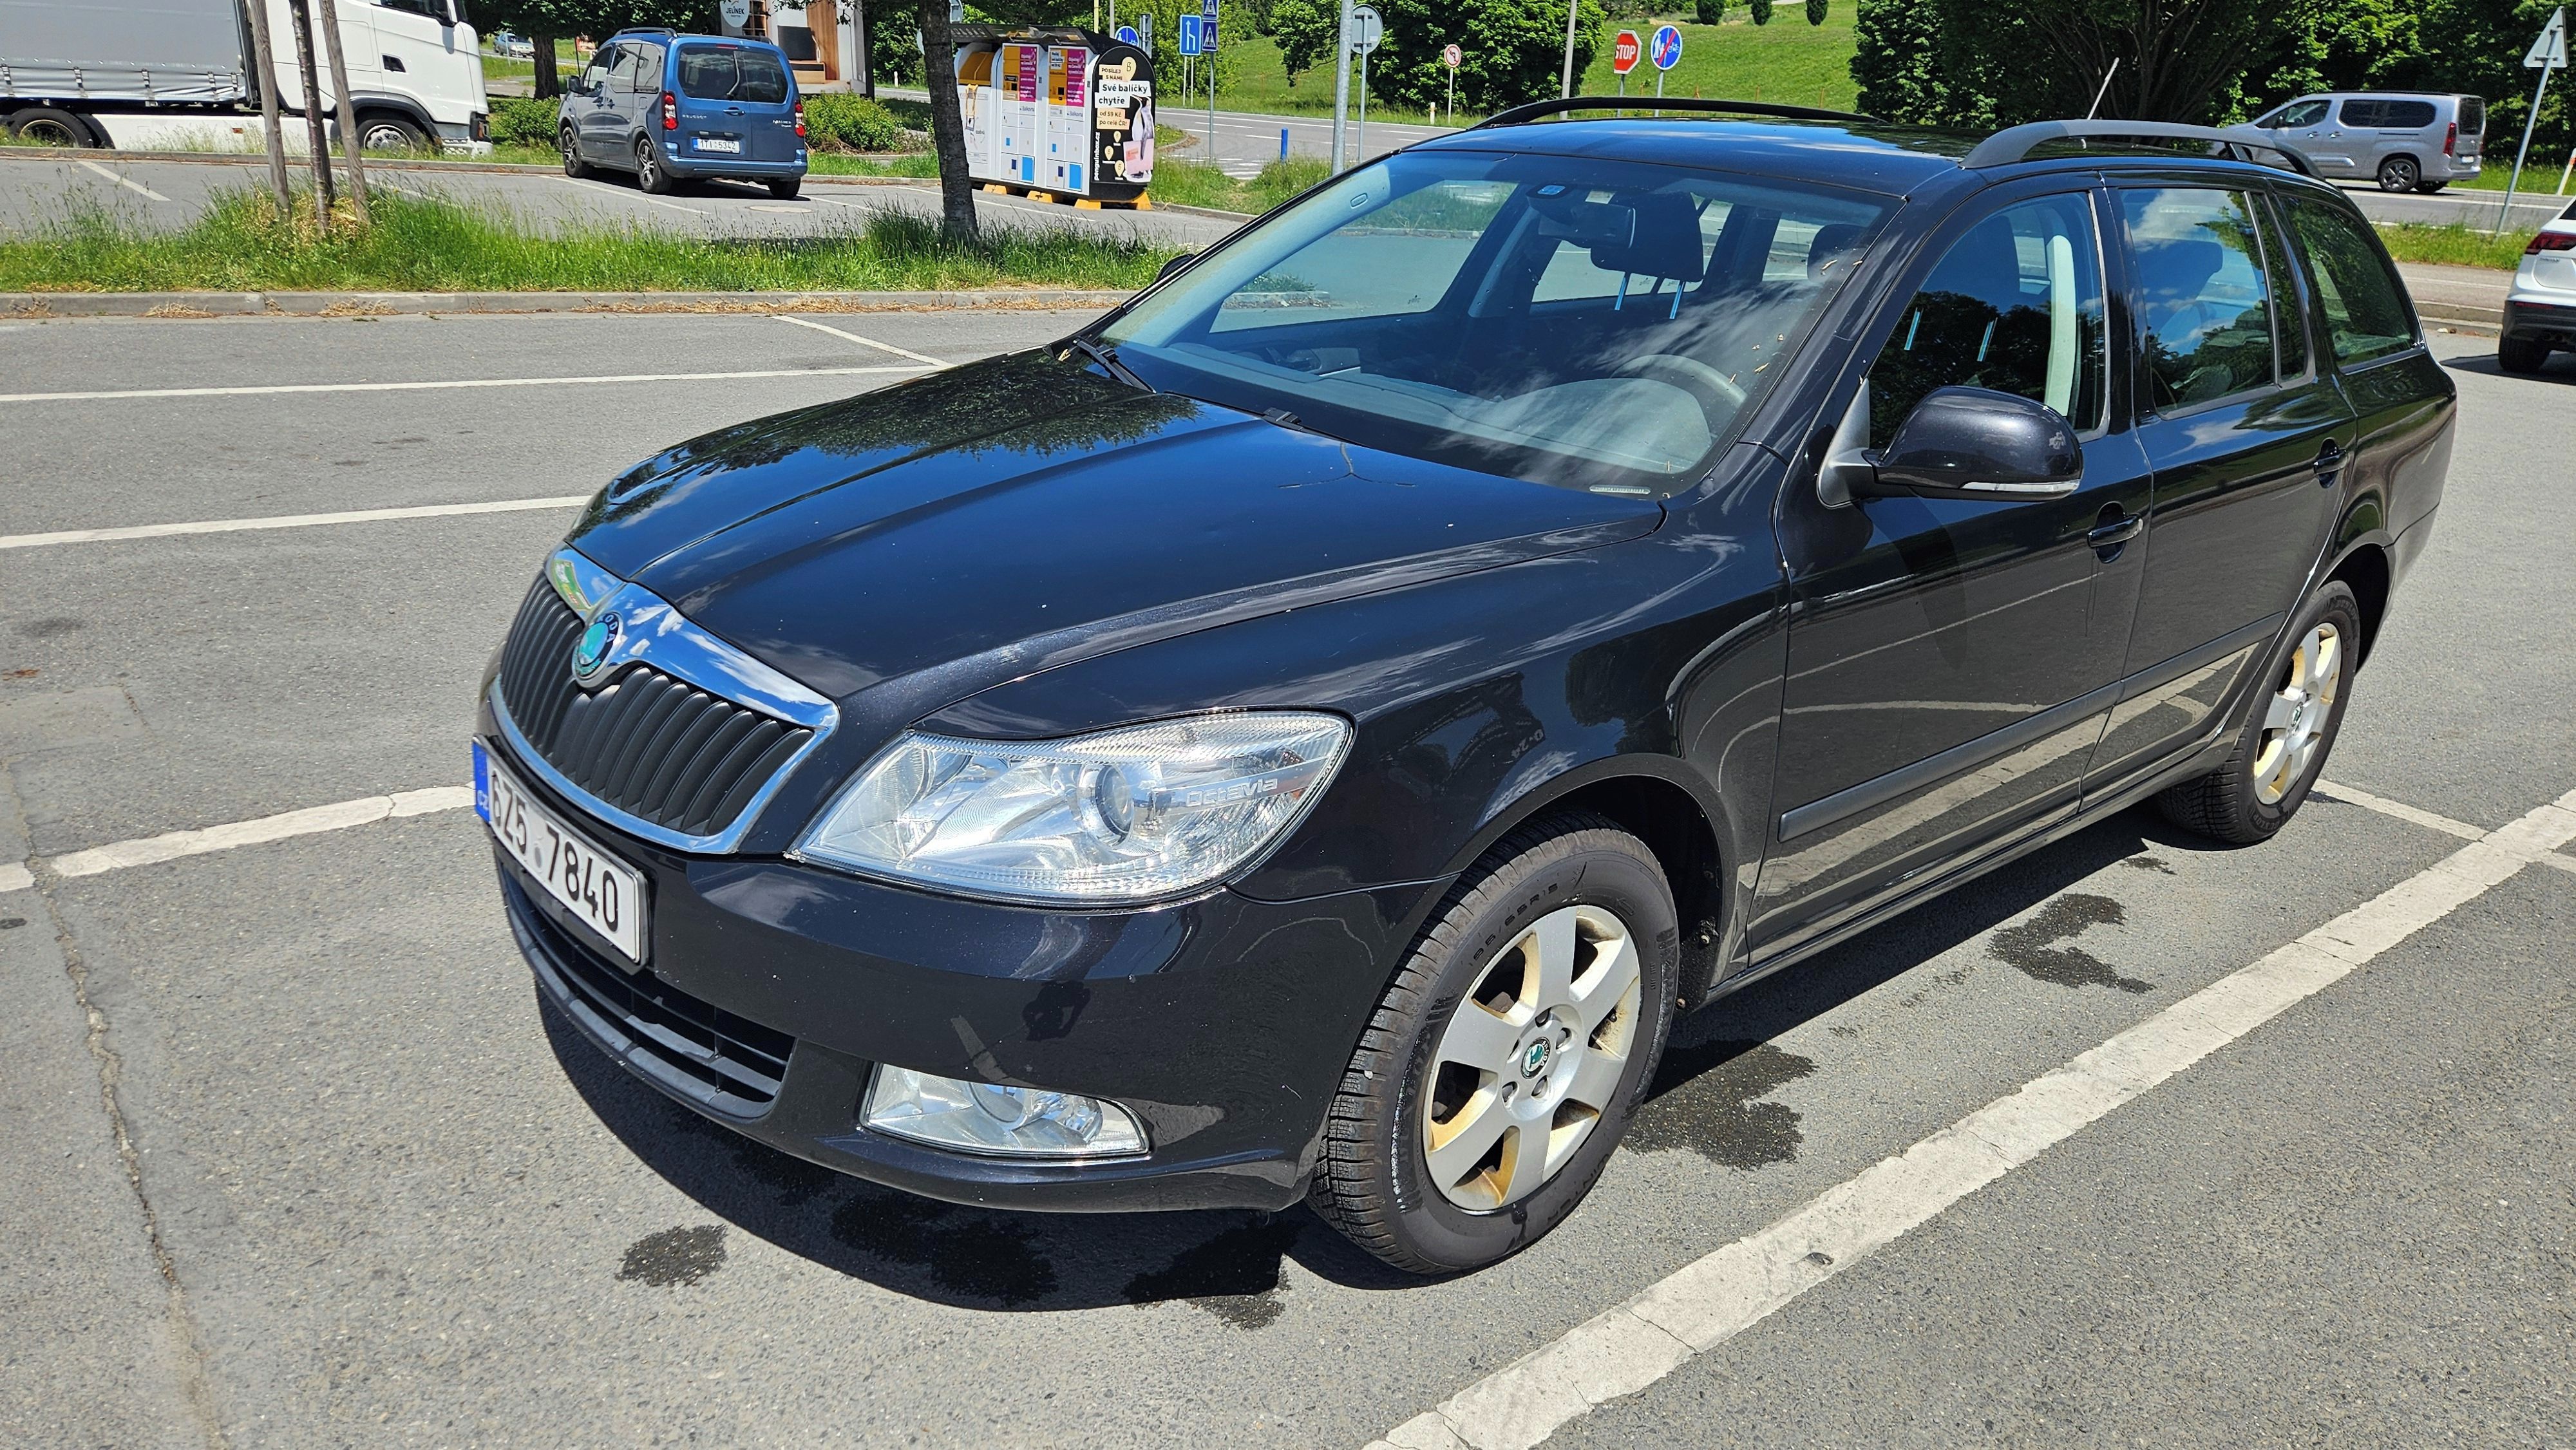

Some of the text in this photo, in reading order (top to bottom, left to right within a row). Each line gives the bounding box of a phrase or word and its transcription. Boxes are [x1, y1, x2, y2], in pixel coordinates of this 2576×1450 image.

[726, 6, 744, 15] JELÍNEK
[1615, 44, 1636, 60] STOP
[1119, 84, 1148, 94] balíčky
[1099, 96, 1125, 106] chytře
[701, 140, 735, 149] 1TI 5342
[491, 771, 619, 932] 6Z5 7840
